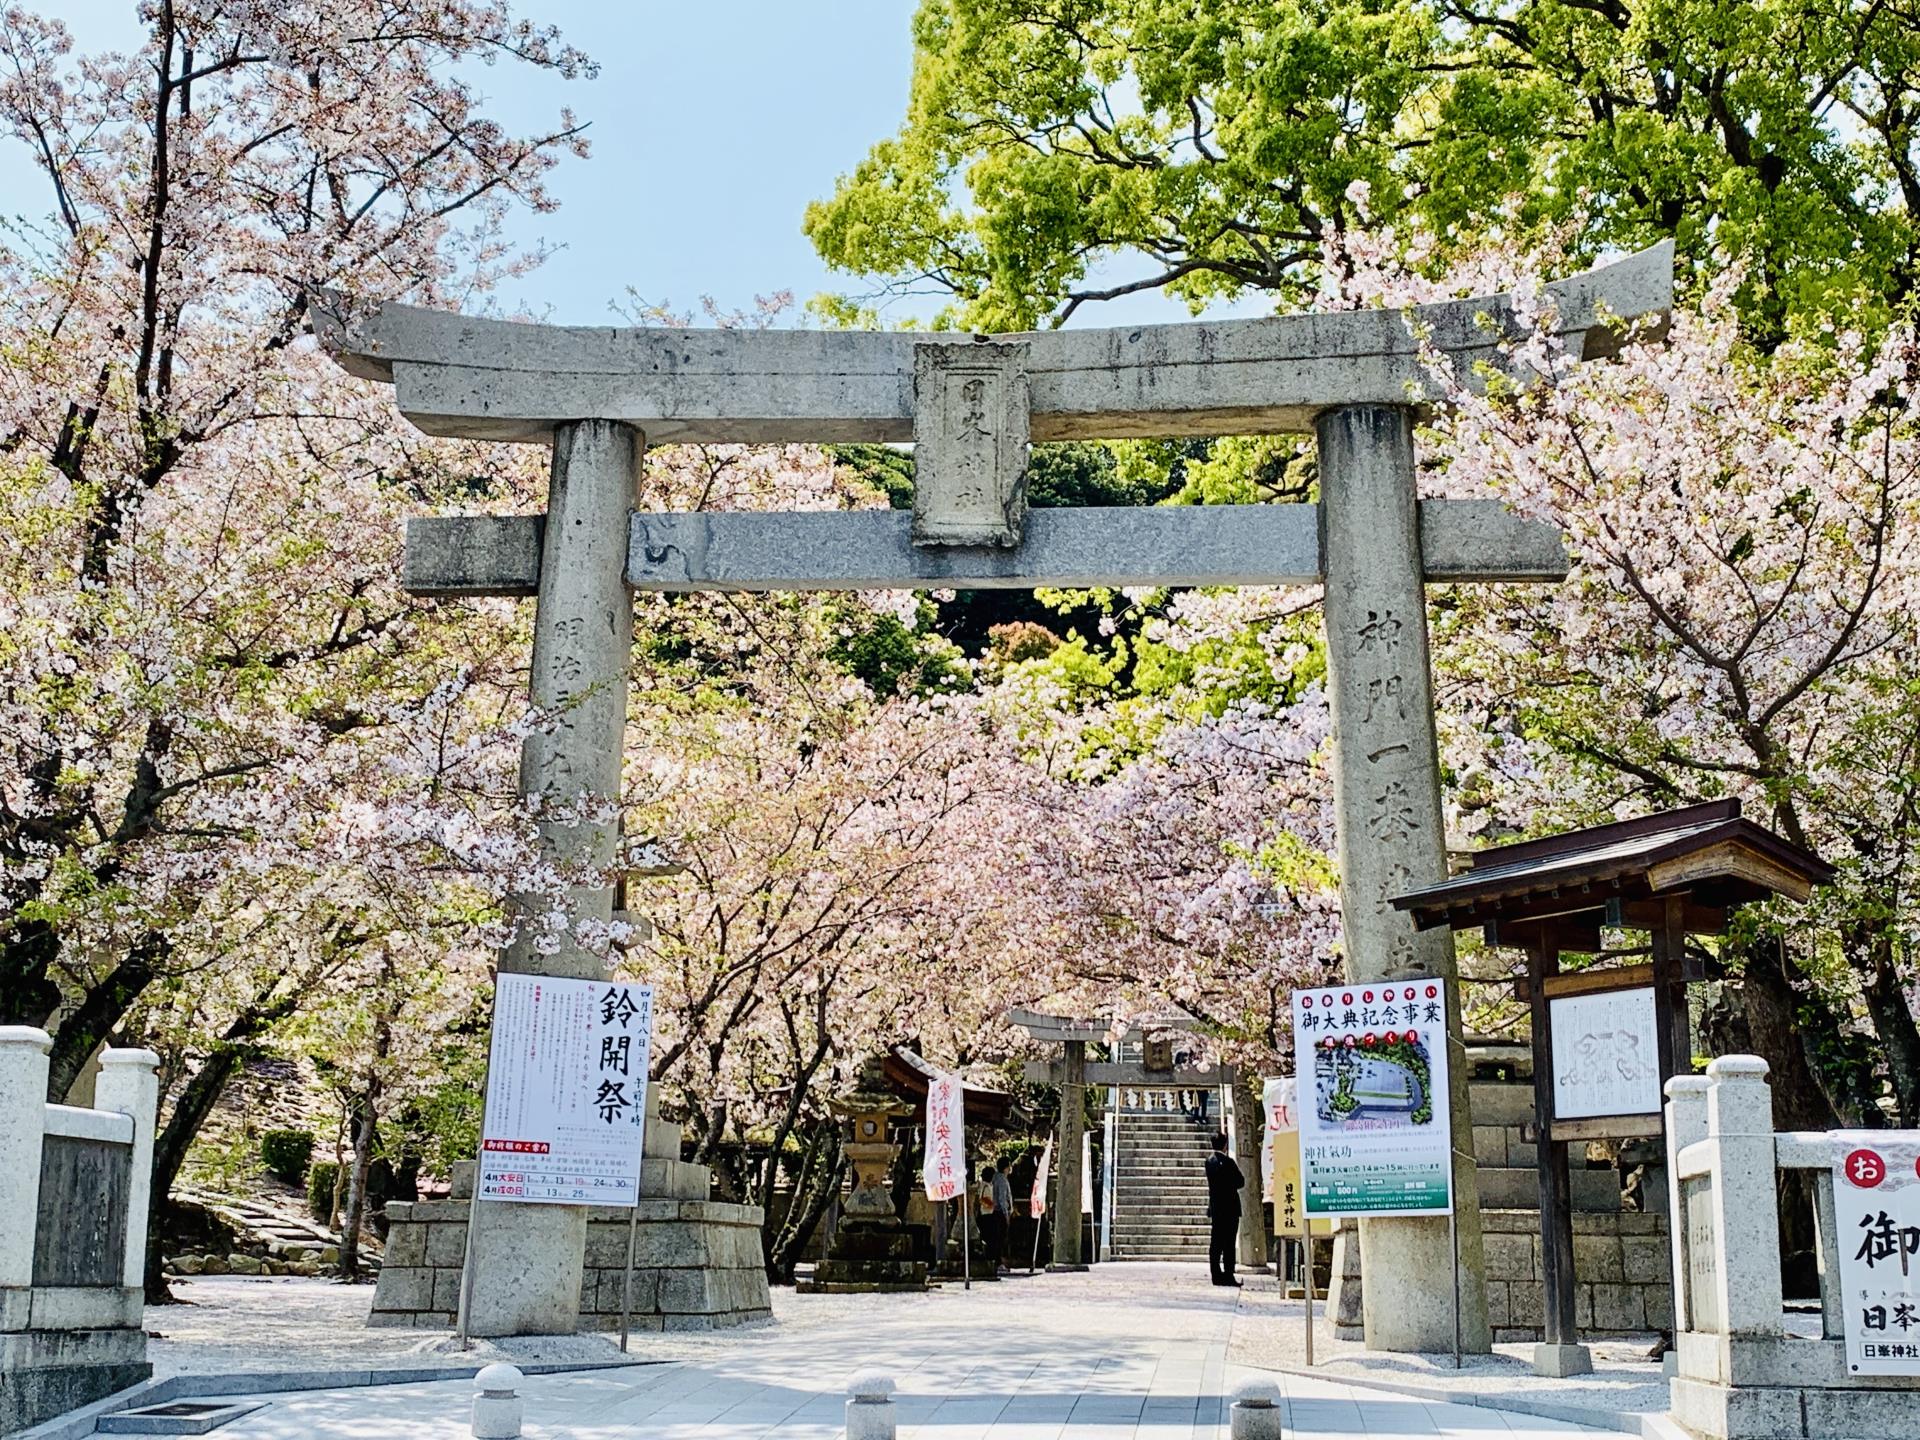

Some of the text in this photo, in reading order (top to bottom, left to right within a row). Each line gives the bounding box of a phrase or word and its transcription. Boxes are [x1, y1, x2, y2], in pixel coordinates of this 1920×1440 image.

[1301, 1001, 1441, 1032] 御大典記念事業
[593, 986, 639, 1125] 鈴開祭
[630, 1077, 645, 1127] 午前十時
[485, 1173, 524, 1183] 4月大安日
[1284, 1183, 1296, 1228] 日峯神社
[1864, 1344, 1919, 1358] 日峯神社
